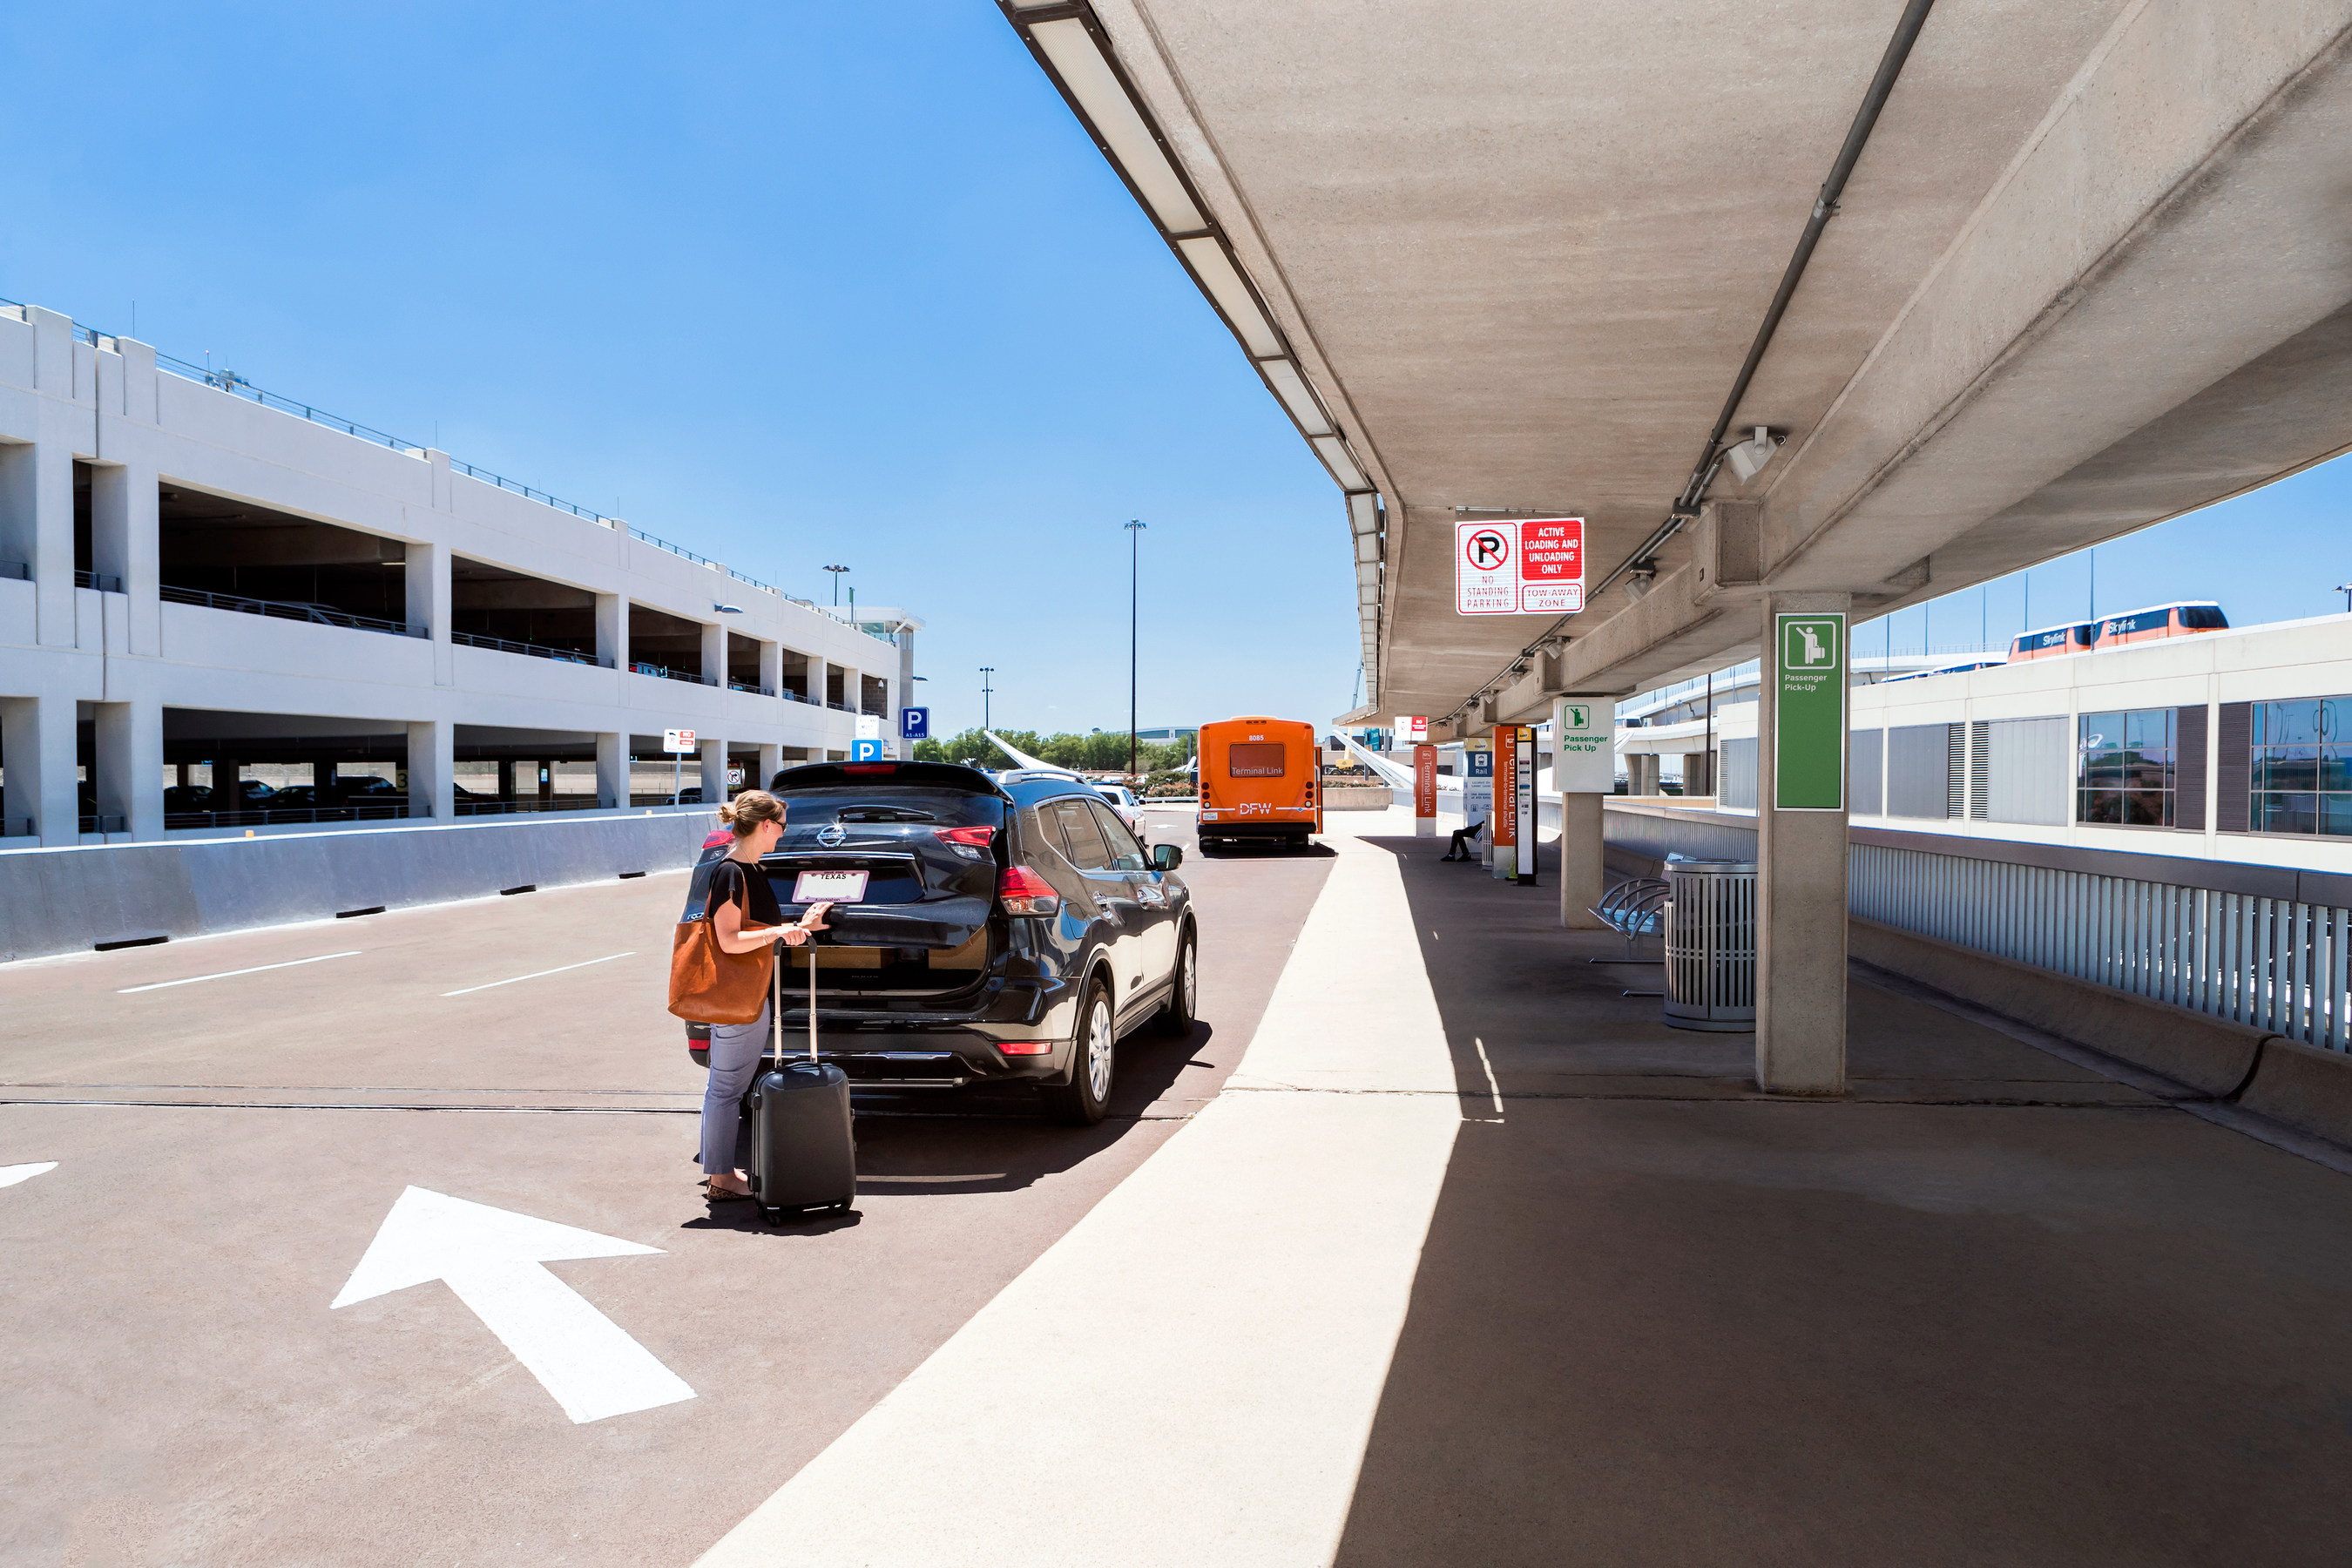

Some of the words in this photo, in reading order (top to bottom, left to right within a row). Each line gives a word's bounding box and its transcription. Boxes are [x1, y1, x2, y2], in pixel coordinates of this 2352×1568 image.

[1538, 527, 1565, 537] ACTIVE
[1524, 540, 1559, 550] LOADING
[1561, 539, 1578, 548] AND
[1529, 551, 1575, 562] UNLOADING
[1541, 564, 1563, 574] ONLY
[1482, 575, 1494, 585] NO
[1467, 586, 1509, 597] STANDING
[1528, 588, 1578, 597] TOW-AWAY
[1467, 598, 1509, 608] PARKING
[1539, 598, 1565, 607] ZONE
[2108, 618, 2136, 635] Skylink
[2043, 632, 2066, 647] Skylink
[1784, 674, 1828, 683] Passenger
[1784, 683, 1816, 693] Pick-Up
[908, 711, 923, 730] P
[1564, 734, 1608, 744] Passenger
[859, 742, 875, 761] P
[1585, 744, 1597, 753] Up
[397, 773, 409, 788] 3
[1240, 803, 1272, 814] DFW
[1423, 796, 1432, 814] Link
